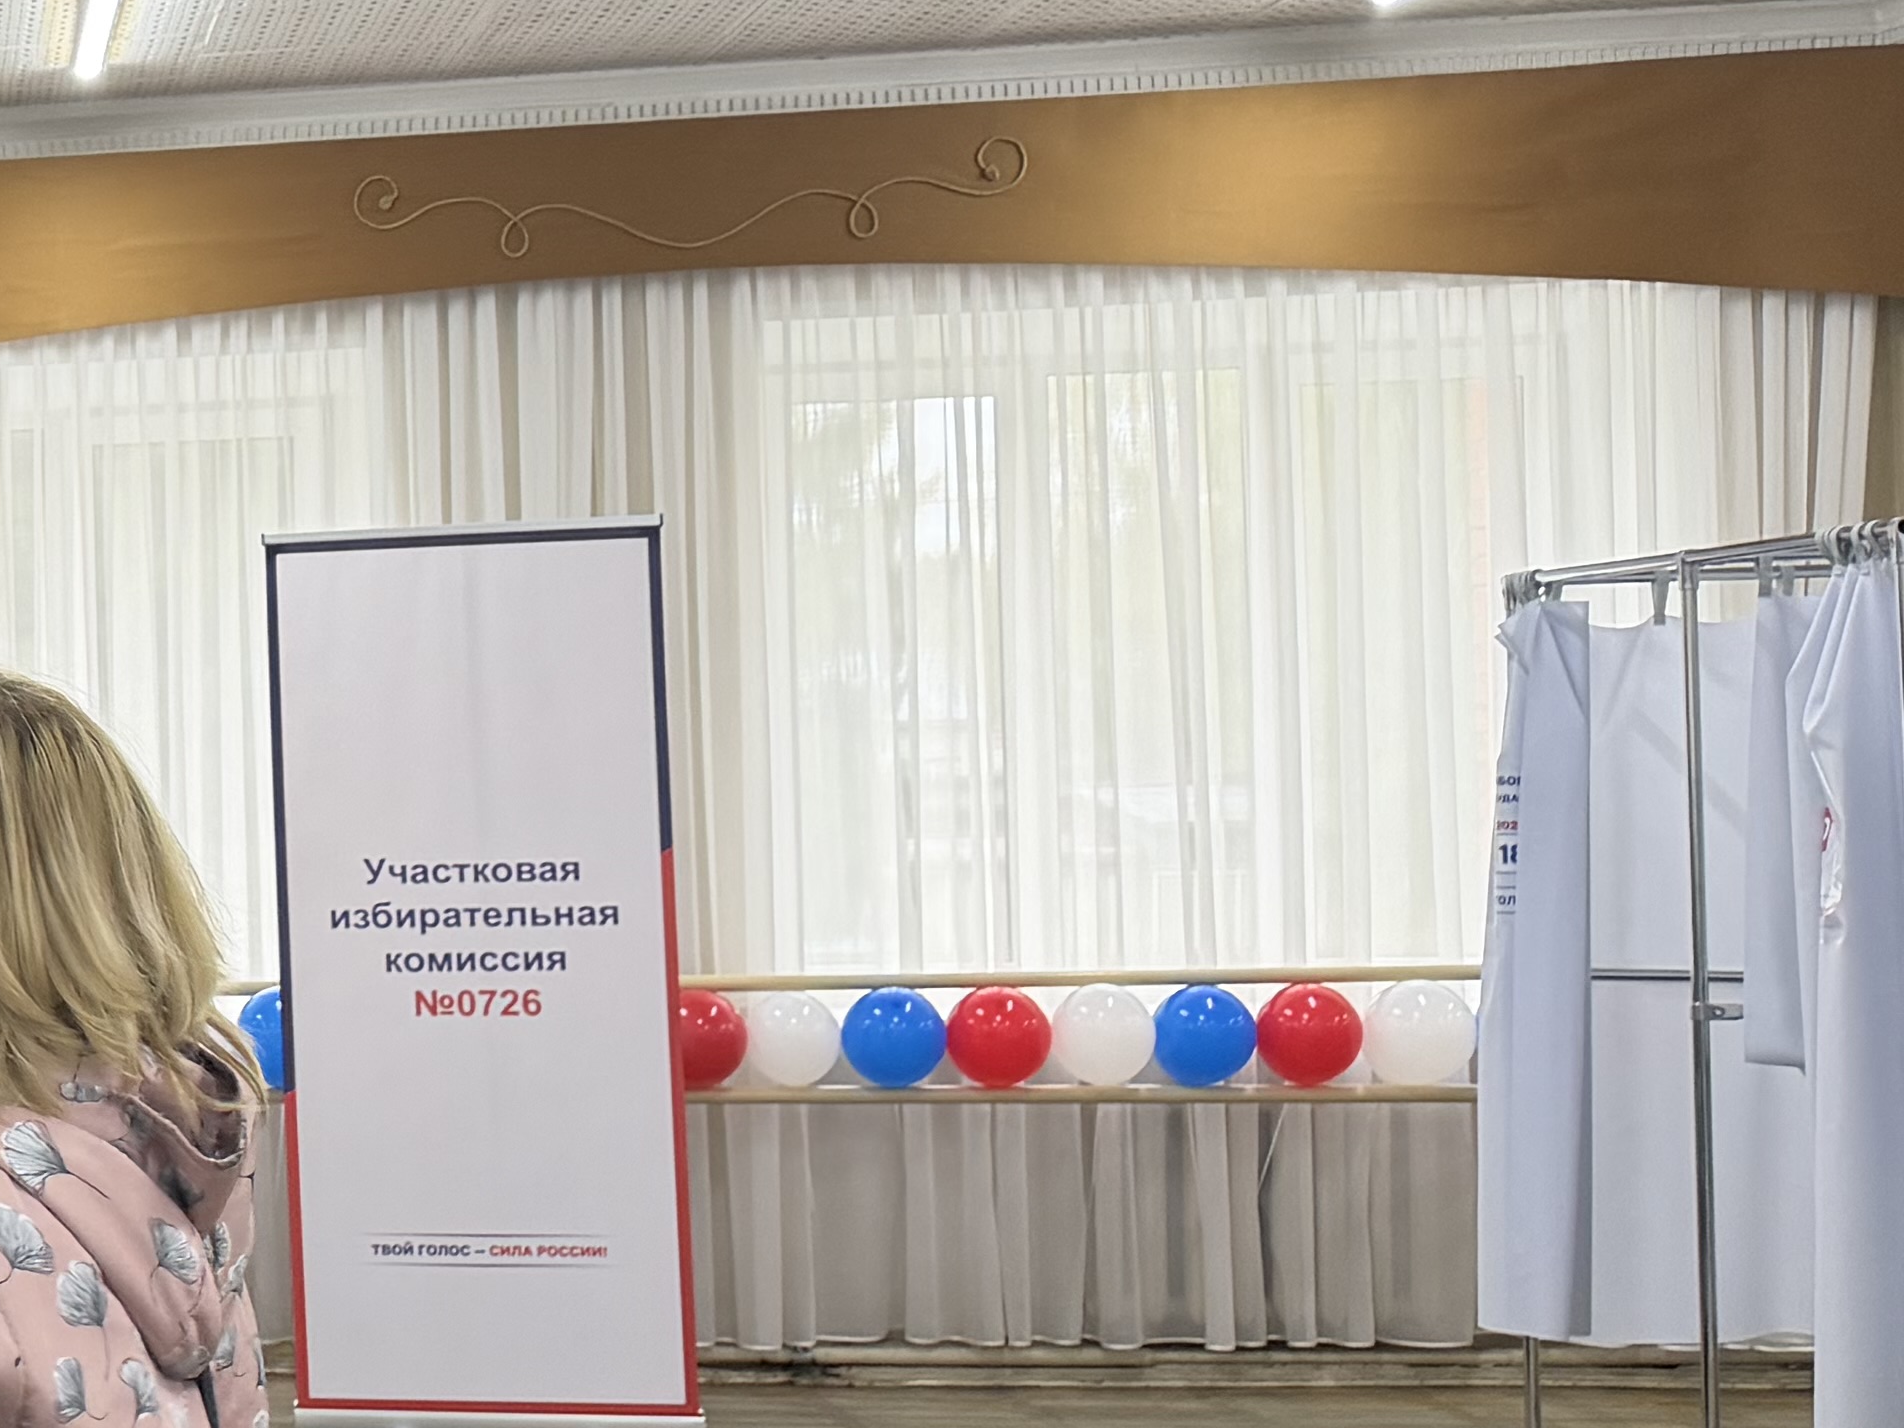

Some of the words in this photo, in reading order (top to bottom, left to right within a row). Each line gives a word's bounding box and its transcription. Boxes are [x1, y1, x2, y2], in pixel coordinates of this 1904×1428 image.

[363, 857, 581, 884] Участковая
[330, 901, 620, 935] избирательная
[385, 950, 567, 973] комиссия
[414, 988, 542, 1017] №0726
[371, 1241, 414, 1256] ТВОЙ
[418, 1243, 471, 1257] ГОЛОС
[489, 1244, 533, 1258] СИЛА
[536, 1245, 608, 1259] РОССИИ!
